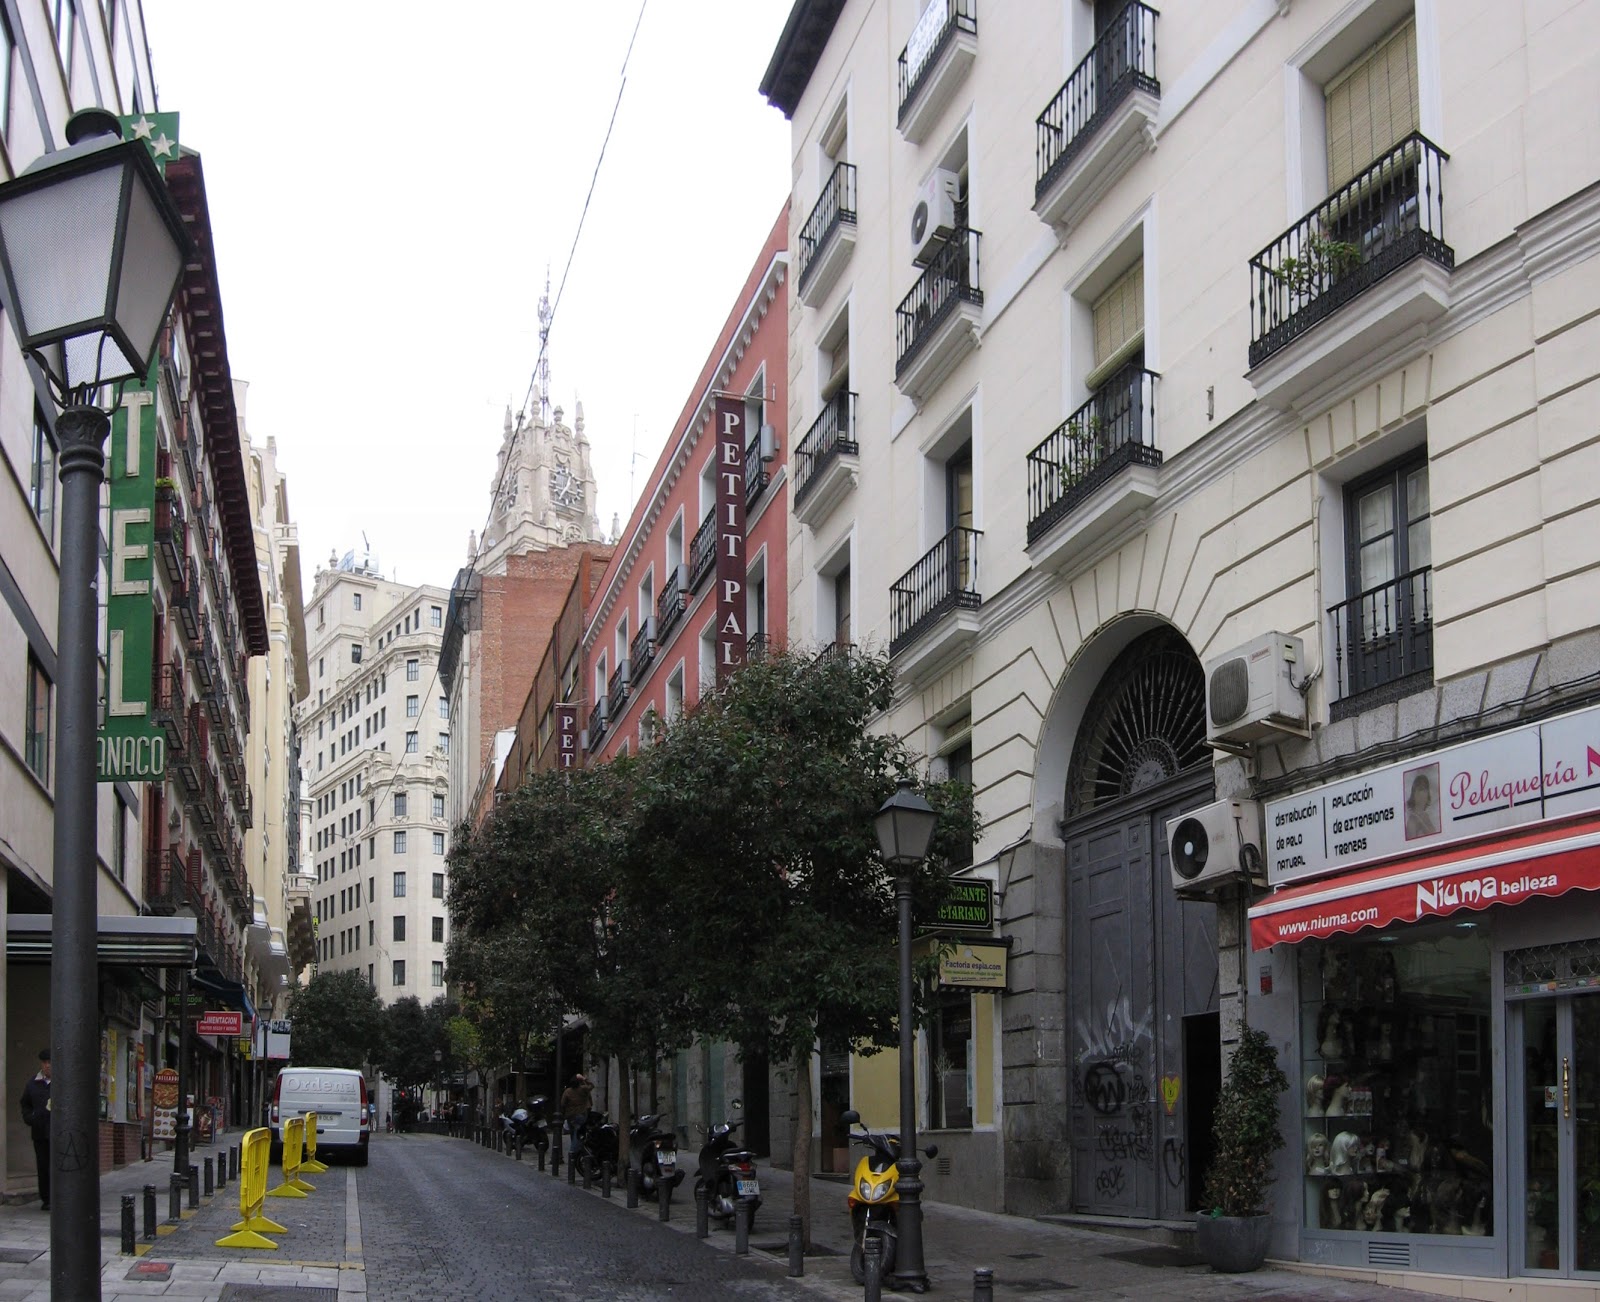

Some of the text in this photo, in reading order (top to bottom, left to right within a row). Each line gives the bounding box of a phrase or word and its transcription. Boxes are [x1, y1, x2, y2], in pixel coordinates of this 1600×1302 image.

[109, 391, 153, 717] TEL
[721, 411, 742, 666] PETIT PAL
[561, 715, 574, 768] PET
[1449, 760, 1578, 810] Peluquería
[1276, 836, 1285, 850] de
[1333, 818, 1343, 834] de
[1416, 875, 1558, 918] Niuma belleza
[1278, 907, 1378, 936] www.niuma.com
[288, 1077, 356, 1092] Ordena
